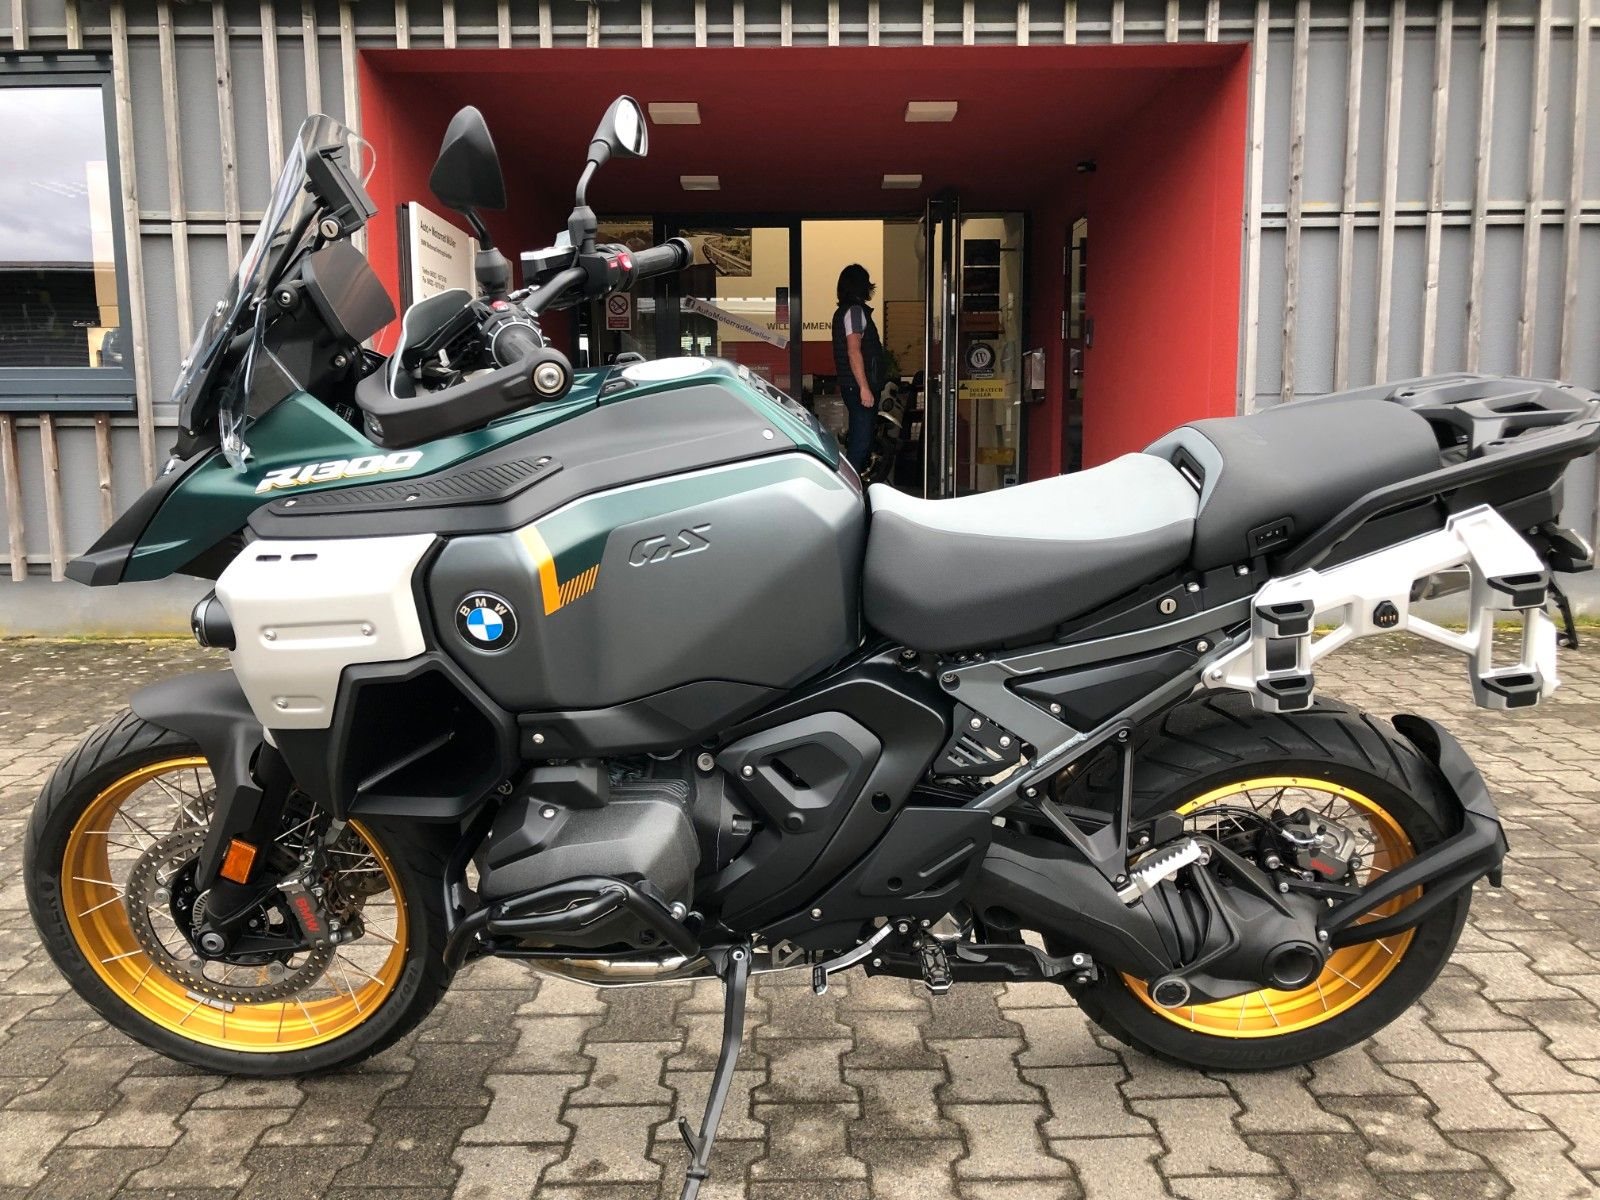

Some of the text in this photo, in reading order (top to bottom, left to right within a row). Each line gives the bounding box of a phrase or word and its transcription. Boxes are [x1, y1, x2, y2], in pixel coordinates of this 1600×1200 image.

[627, 522, 713, 568] GS
[459, 597, 508, 618] BMW
[295, 896, 321, 933] BMW
